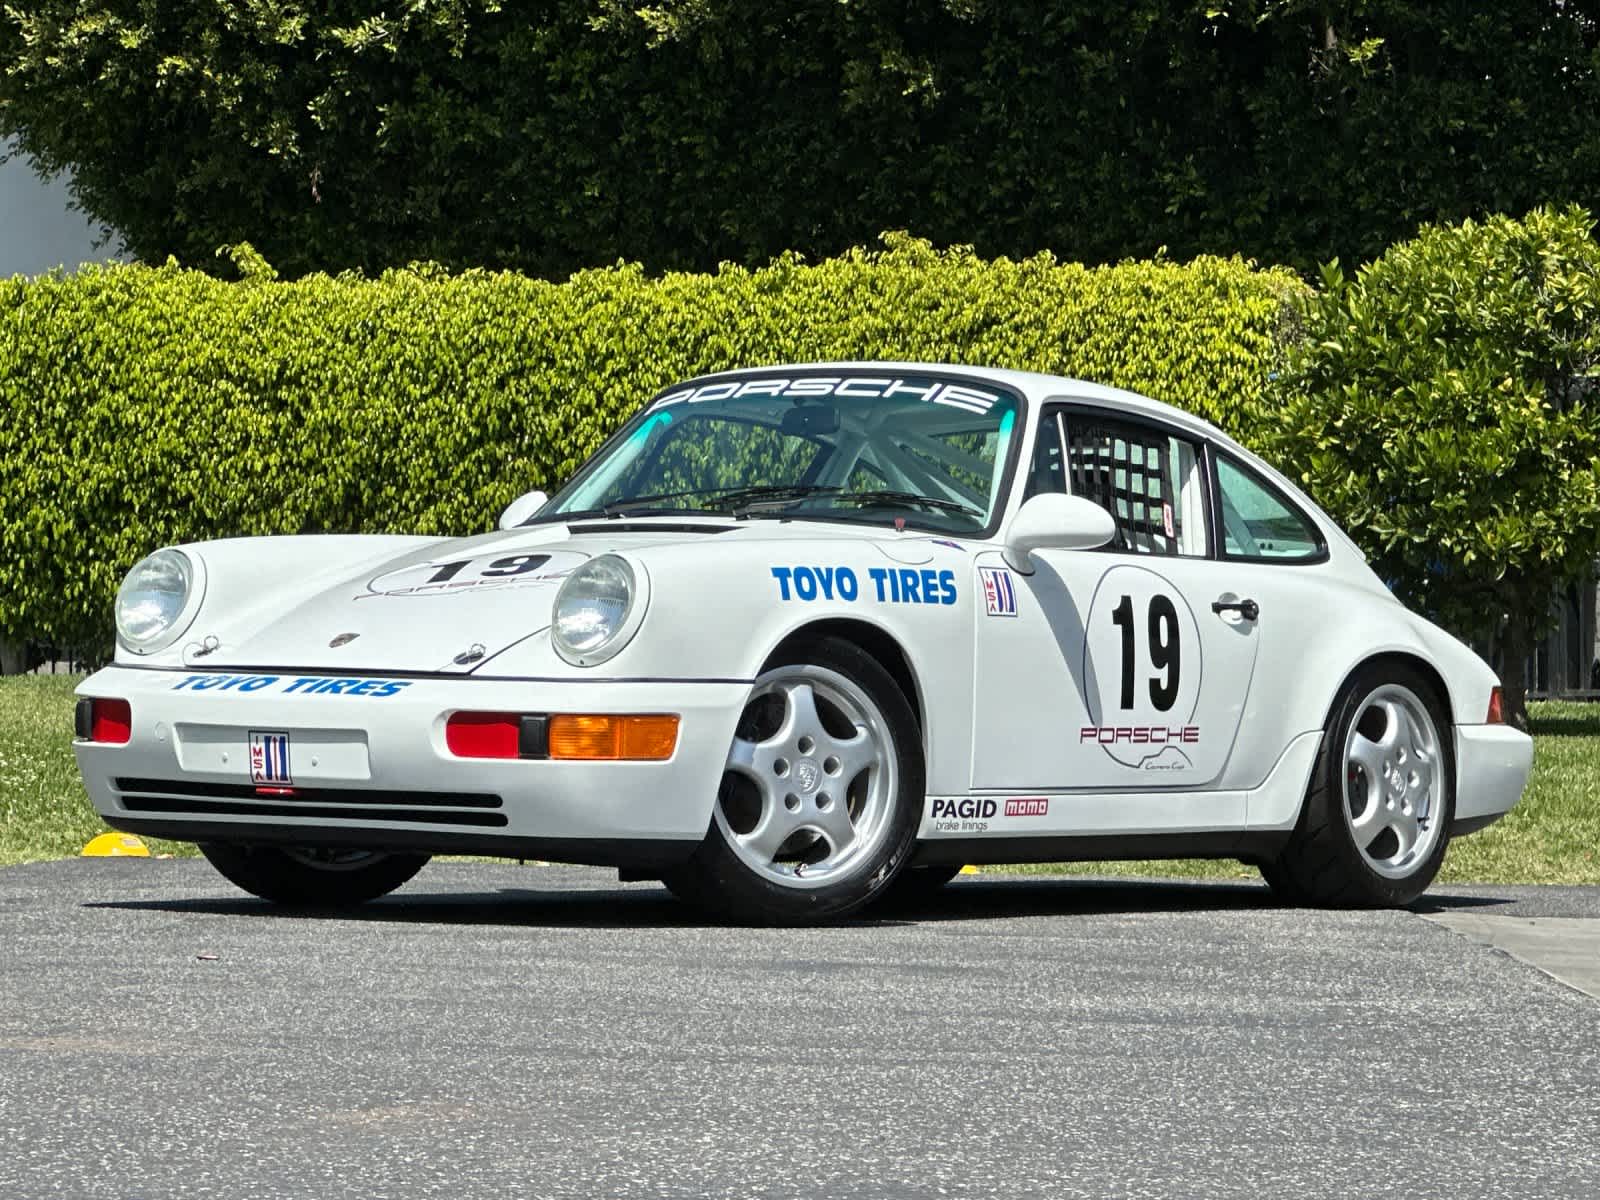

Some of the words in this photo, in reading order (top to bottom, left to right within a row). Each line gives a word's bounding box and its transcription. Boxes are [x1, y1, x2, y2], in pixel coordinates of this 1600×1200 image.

[645, 377, 1000, 415] PORSCHE
[426, 553, 553, 584] 19
[771, 566, 859, 602] TOYO
[868, 567, 957, 606] TIRES
[1112, 593, 1181, 712] 19
[172, 675, 280, 693] TOYO
[282, 678, 414, 698] TIRES
[1080, 726, 1200, 745] PORSCHE
[931, 799, 998, 819] PAGID
[936, 819, 960, 831] brake
[961, 820, 989, 833] linings
